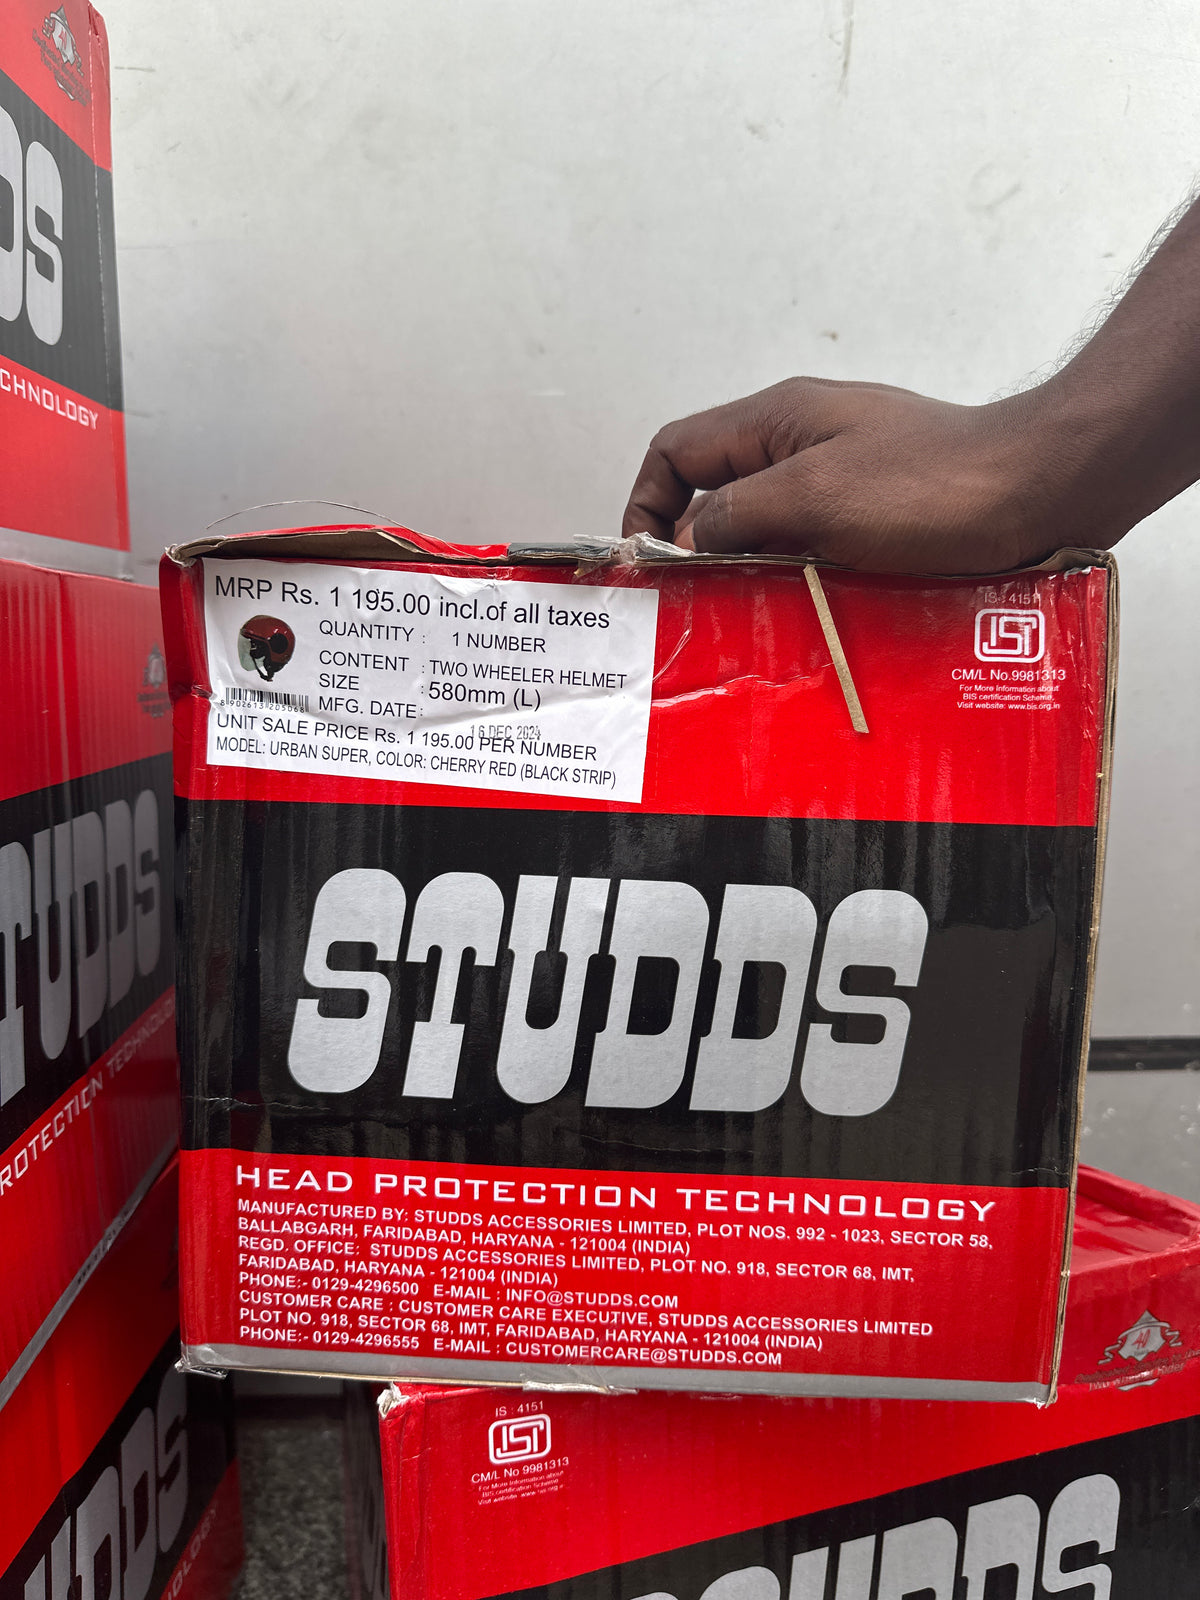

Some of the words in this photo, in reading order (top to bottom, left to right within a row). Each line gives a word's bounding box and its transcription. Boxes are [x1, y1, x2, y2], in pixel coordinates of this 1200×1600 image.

[215, 575, 272, 599] MRP
[281, 581, 319, 605] Rs.
[330, 586, 339, 607] 1
[352, 588, 430, 616] 195.00
[513, 602, 540, 624] all
[547, 604, 610, 629] taxes
[319, 619, 414, 642] QUANTITY
[452, 632, 459, 647] 1
[467, 633, 546, 653] NUMBER
[319, 650, 409, 672] CONTENT
[429, 660, 467, 677] TWO
[473, 663, 554, 684] WHEELER
[560, 670, 627, 689] HELMET
[951, 668, 987, 681] CM/L
[319, 673, 359, 691] SIZE
[429, 681, 505, 705] 580mm
[513, 688, 541, 711] (L)
[319, 695, 363, 714] MFG.
[217, 713, 257, 731] UNIT
[262, 717, 308, 735] SALE
[314, 722, 368, 741] PRICE
[375, 728, 400, 744] Rs.
[407, 730, 414, 745] 1
[422, 732, 474, 750] 195.00
[479, 737, 515, 754] PER
[520, 740, 597, 761] NUMBER
[488, 724, 513, 740] DEC
[216, 736, 266, 754] MODEL:
[270, 741, 317, 759] URBAN
[321, 745, 371, 766] SUPER,
[376, 751, 426, 769] COLOR:
[430, 755, 486, 774] CHERRY
[489, 761, 517, 777] RED
[520, 764, 568, 782] (BLACK
[572, 768, 616, 790] STRIP)
[287, 867, 929, 1117] STUDDS
[236, 1165, 353, 1192] HEAD
[375, 1173, 656, 1209] PROTECTION
[676, 1188, 996, 1222] TECHNOLOGY
[238, 1198, 377, 1220] MANUFACTURED
[382, 1207, 408, 1222] BY:
[414, 1209, 483, 1227] STUDDS
[488, 1214, 612, 1233] ACCESSORIES
[618, 1219, 691, 1237] LIMITED,
[697, 1223, 744, 1239] PLOT
[749, 1225, 790, 1240] NOS.
[796, 1227, 825, 1241] 992
[842, 1228, 885, 1245] 1023,
[890, 1230, 964, 1247] SECTOR
[969, 1234, 993, 1250] 58,
[238, 1217, 359, 1239] BALLABGARH,
[363, 1224, 466, 1245] FARIDABAD,
[472, 1229, 554, 1249] HARYANA
[570, 1236, 627, 1252] 121004
[632, 1239, 690, 1257] (INDIA)
[238, 1235, 288, 1252] REGD.
[294, 1240, 361, 1256] OFFICE:
[370, 1243, 438, 1260] STUDDS
[443, 1247, 566, 1268] ACCESSORIES
[572, 1255, 645, 1273] LIMITED,
[650, 1258, 696, 1274] PLOT
[701, 1261, 731, 1275] NO.
[737, 1262, 770, 1278] 918,
[775, 1263, 847, 1279] SECTOR
[852, 1266, 876, 1281] 68,
[882, 1267, 915, 1283] IMT,
[238, 1253, 339, 1274] FARIDABAD,
[344, 1260, 425, 1278] HARYANA
[440, 1267, 495, 1282] 121004
[500, 1270, 558, 1288] (INDIA)
[312, 1277, 419, 1296] 0129-4296500
[434, 1284, 490, 1300] E-MAIL
[506, 1288, 679, 1309] INFO@STUDDS.COM
[239, 1290, 332, 1308] CUSTOMER
[337, 1296, 384, 1311] CARE
[399, 1300, 494, 1319] CUSTOMER
[499, 1306, 547, 1321] CARE
[552, 1308, 652, 1328] EXECUTIVE,
[658, 1312, 728, 1328] STUDDS
[733, 1316, 858, 1332] ACCESSORIES
[864, 1319, 933, 1336] LIMITED
[240, 1308, 282, 1324] PLOT
[287, 1312, 316, 1326] NO.
[321, 1314, 353, 1329] 918,
[358, 1315, 426, 1332] SECTOR
[431, 1319, 454, 1335] 68,
[459, 1321, 491, 1337] IMT,
[496, 1324, 600, 1343] FARIDABAD,
[605, 1328, 688, 1345] HARYANA
[703, 1332, 759, 1347] 121004
[765, 1335, 823, 1351] (INDIA)
[313, 1331, 419, 1350] 0129-4296555
[433, 1338, 491, 1354] E-MAIL
[506, 1342, 781, 1366] CUSTOMERCARE@STUDDS.COM
[495, 1406, 507, 1417] IS
[517, 1400, 544, 1414] 4151
[471, 1470, 501, 1484] CM/L
